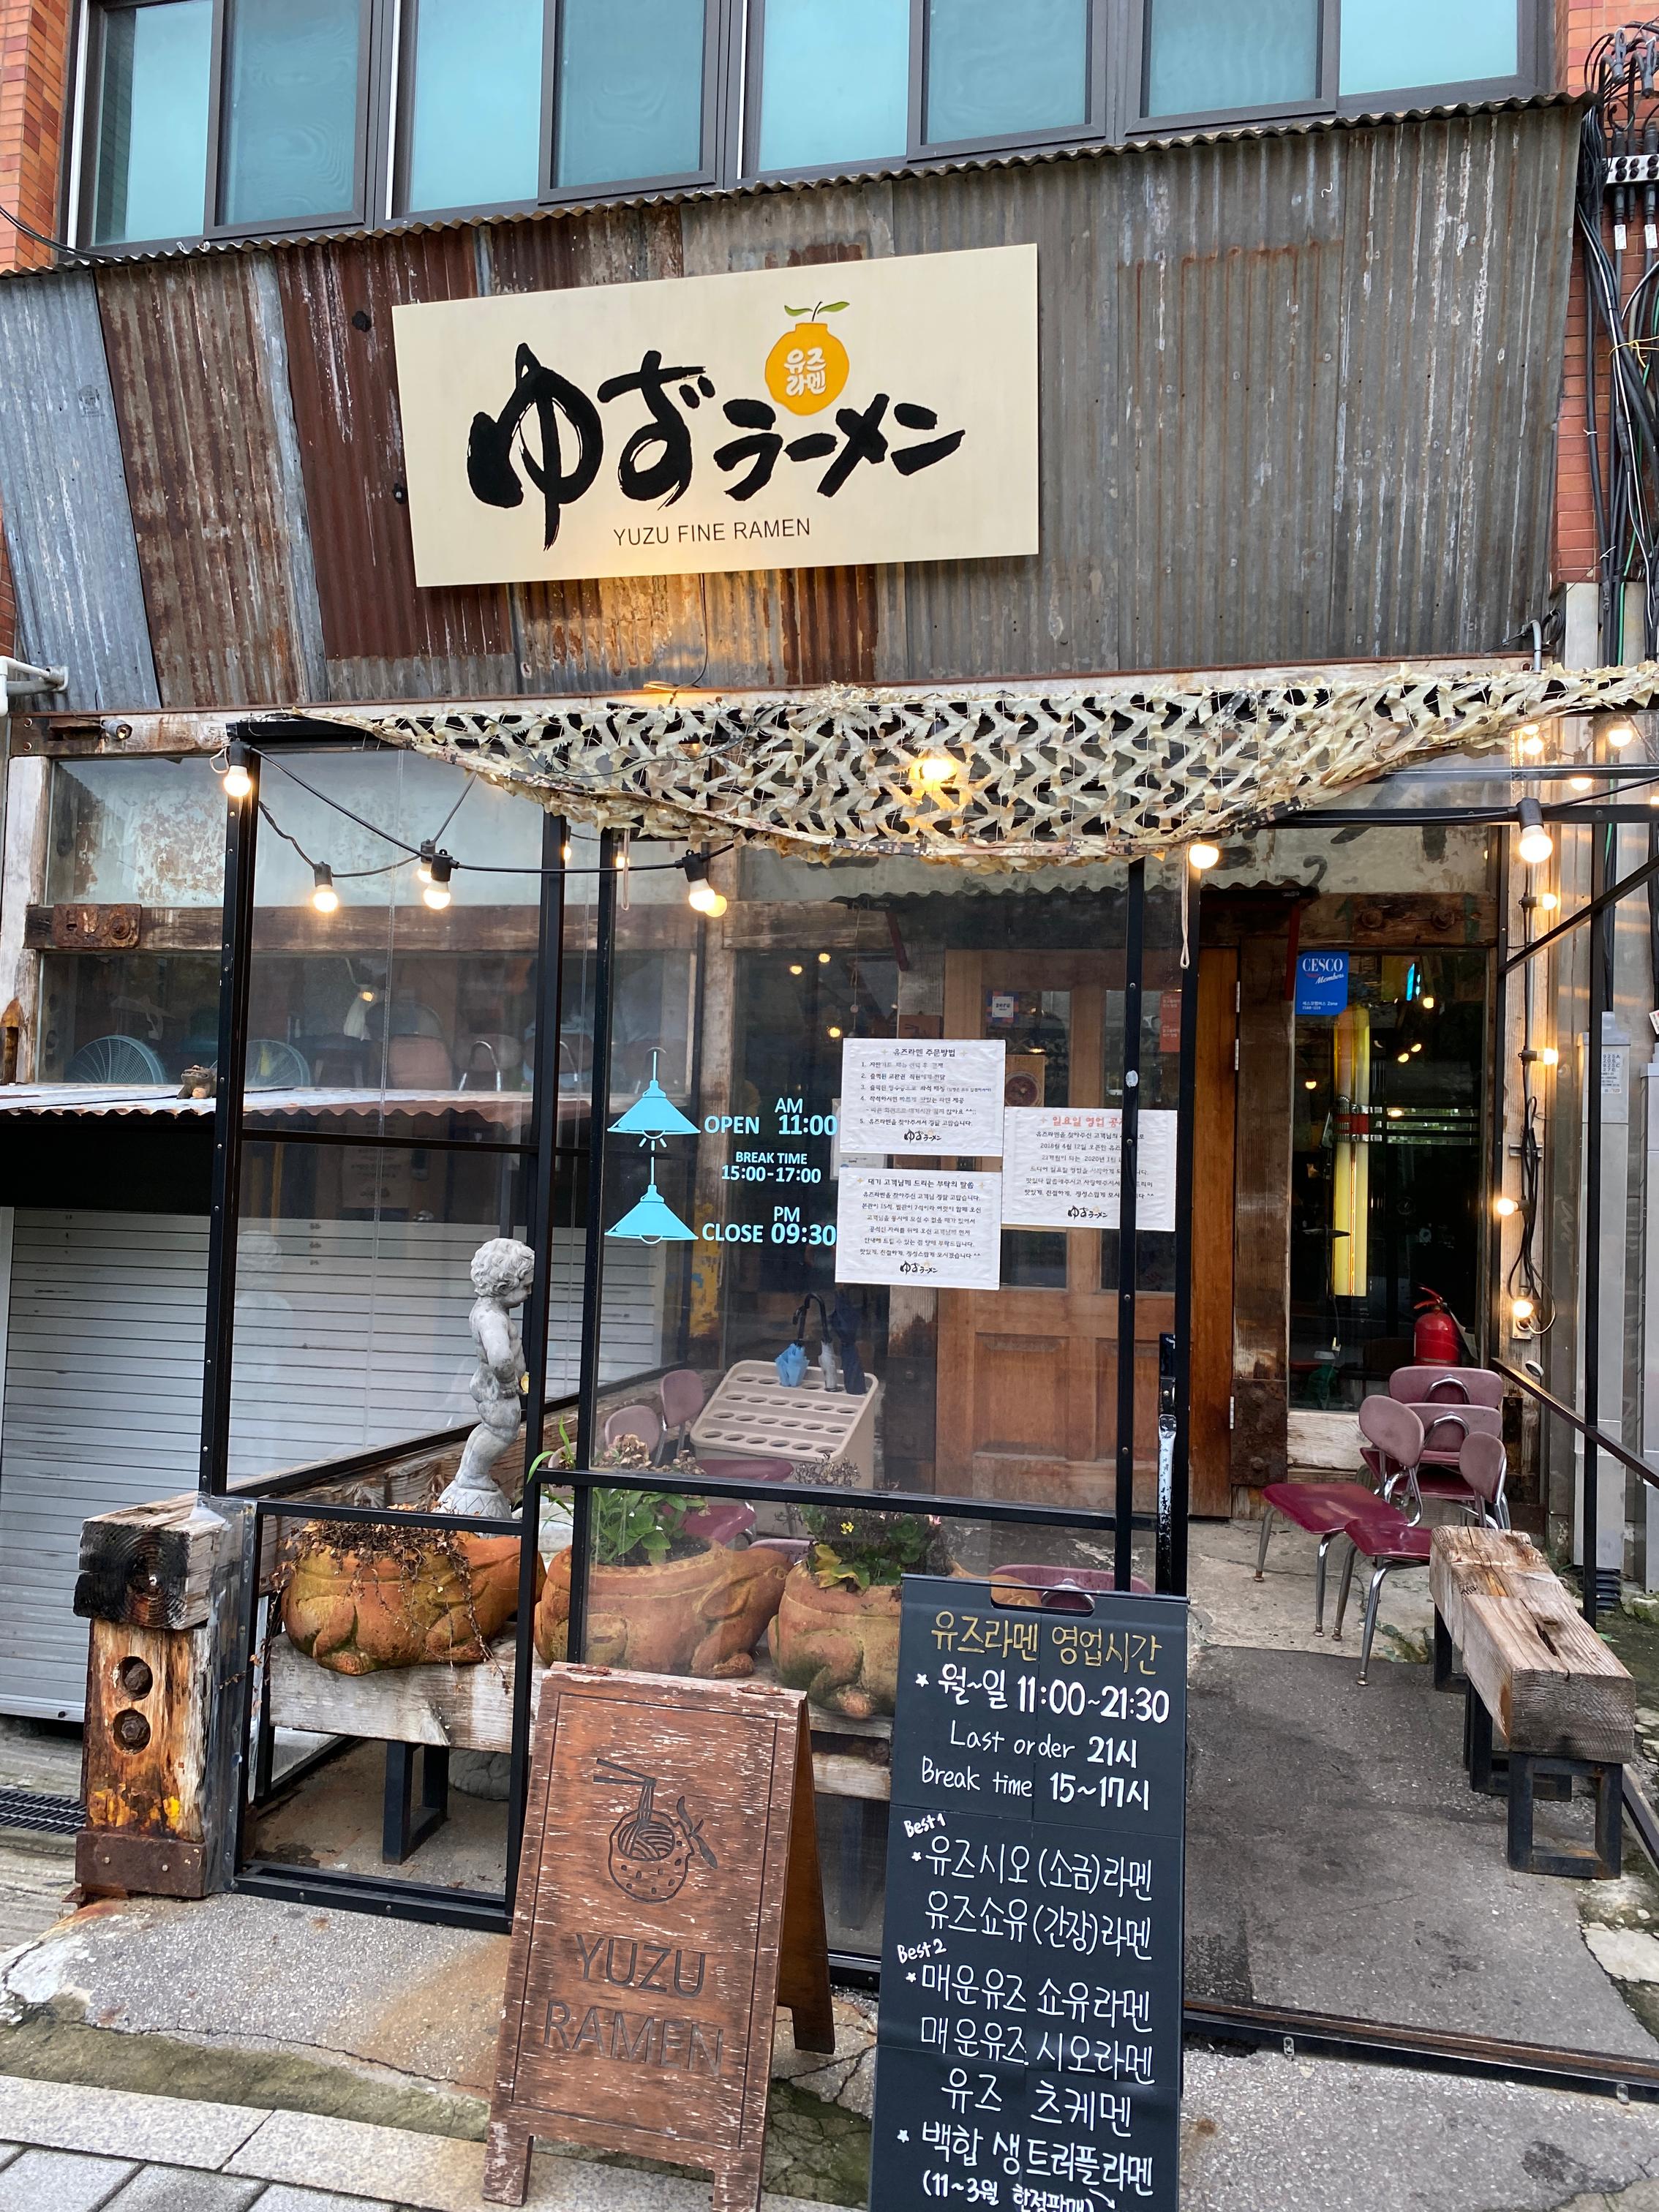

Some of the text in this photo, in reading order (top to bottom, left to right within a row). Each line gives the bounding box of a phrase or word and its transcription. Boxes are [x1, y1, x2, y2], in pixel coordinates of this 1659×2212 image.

[784, 347, 826, 374] 유즈
[786, 370, 826, 396] 라멘
[467, 343, 966, 551] ゆずラーメン
[613, 518, 810, 546] YUZU FINE RAMEN
[1302, 958, 1343, 972] CESCO
[1315, 972, 1344, 985] Members
[893, 1048, 955, 1057] 유즈라멘 주문방법
[774, 1097, 803, 1113] AM
[704, 1114, 838, 1135] OPEN 11:00
[1053, 1116, 1081, 1126] 일요일
[1086, 1117, 1104, 1127] 영업
[735, 1151, 808, 1165] BREAK TIME
[721, 1165, 821, 1184] 15:00-17:00
[774, 1206, 800, 1222] PM
[702, 1223, 838, 1246] CLOSE 09:30
[931, 1610, 1163, 1675] 유즈라멘 영업시간
[938, 1663, 1170, 1723] 월~일 11:00~21:30
[950, 1720, 1137, 1769] Last order 21시
[922, 1756, 1149, 1811] Break time 15~17시
[576, 1933, 706, 1998] YUZU
[922, 1964, 1153, 2033] 매운유즈 쇼유라멘
[543, 2001, 724, 2077] RAMEN
[921, 2017, 1156, 2085] 매운유즈 시오라멘
[941, 2068, 1132, 2137] 유즈 츠케멘
[922, 2121, 984, 2167] 백합
